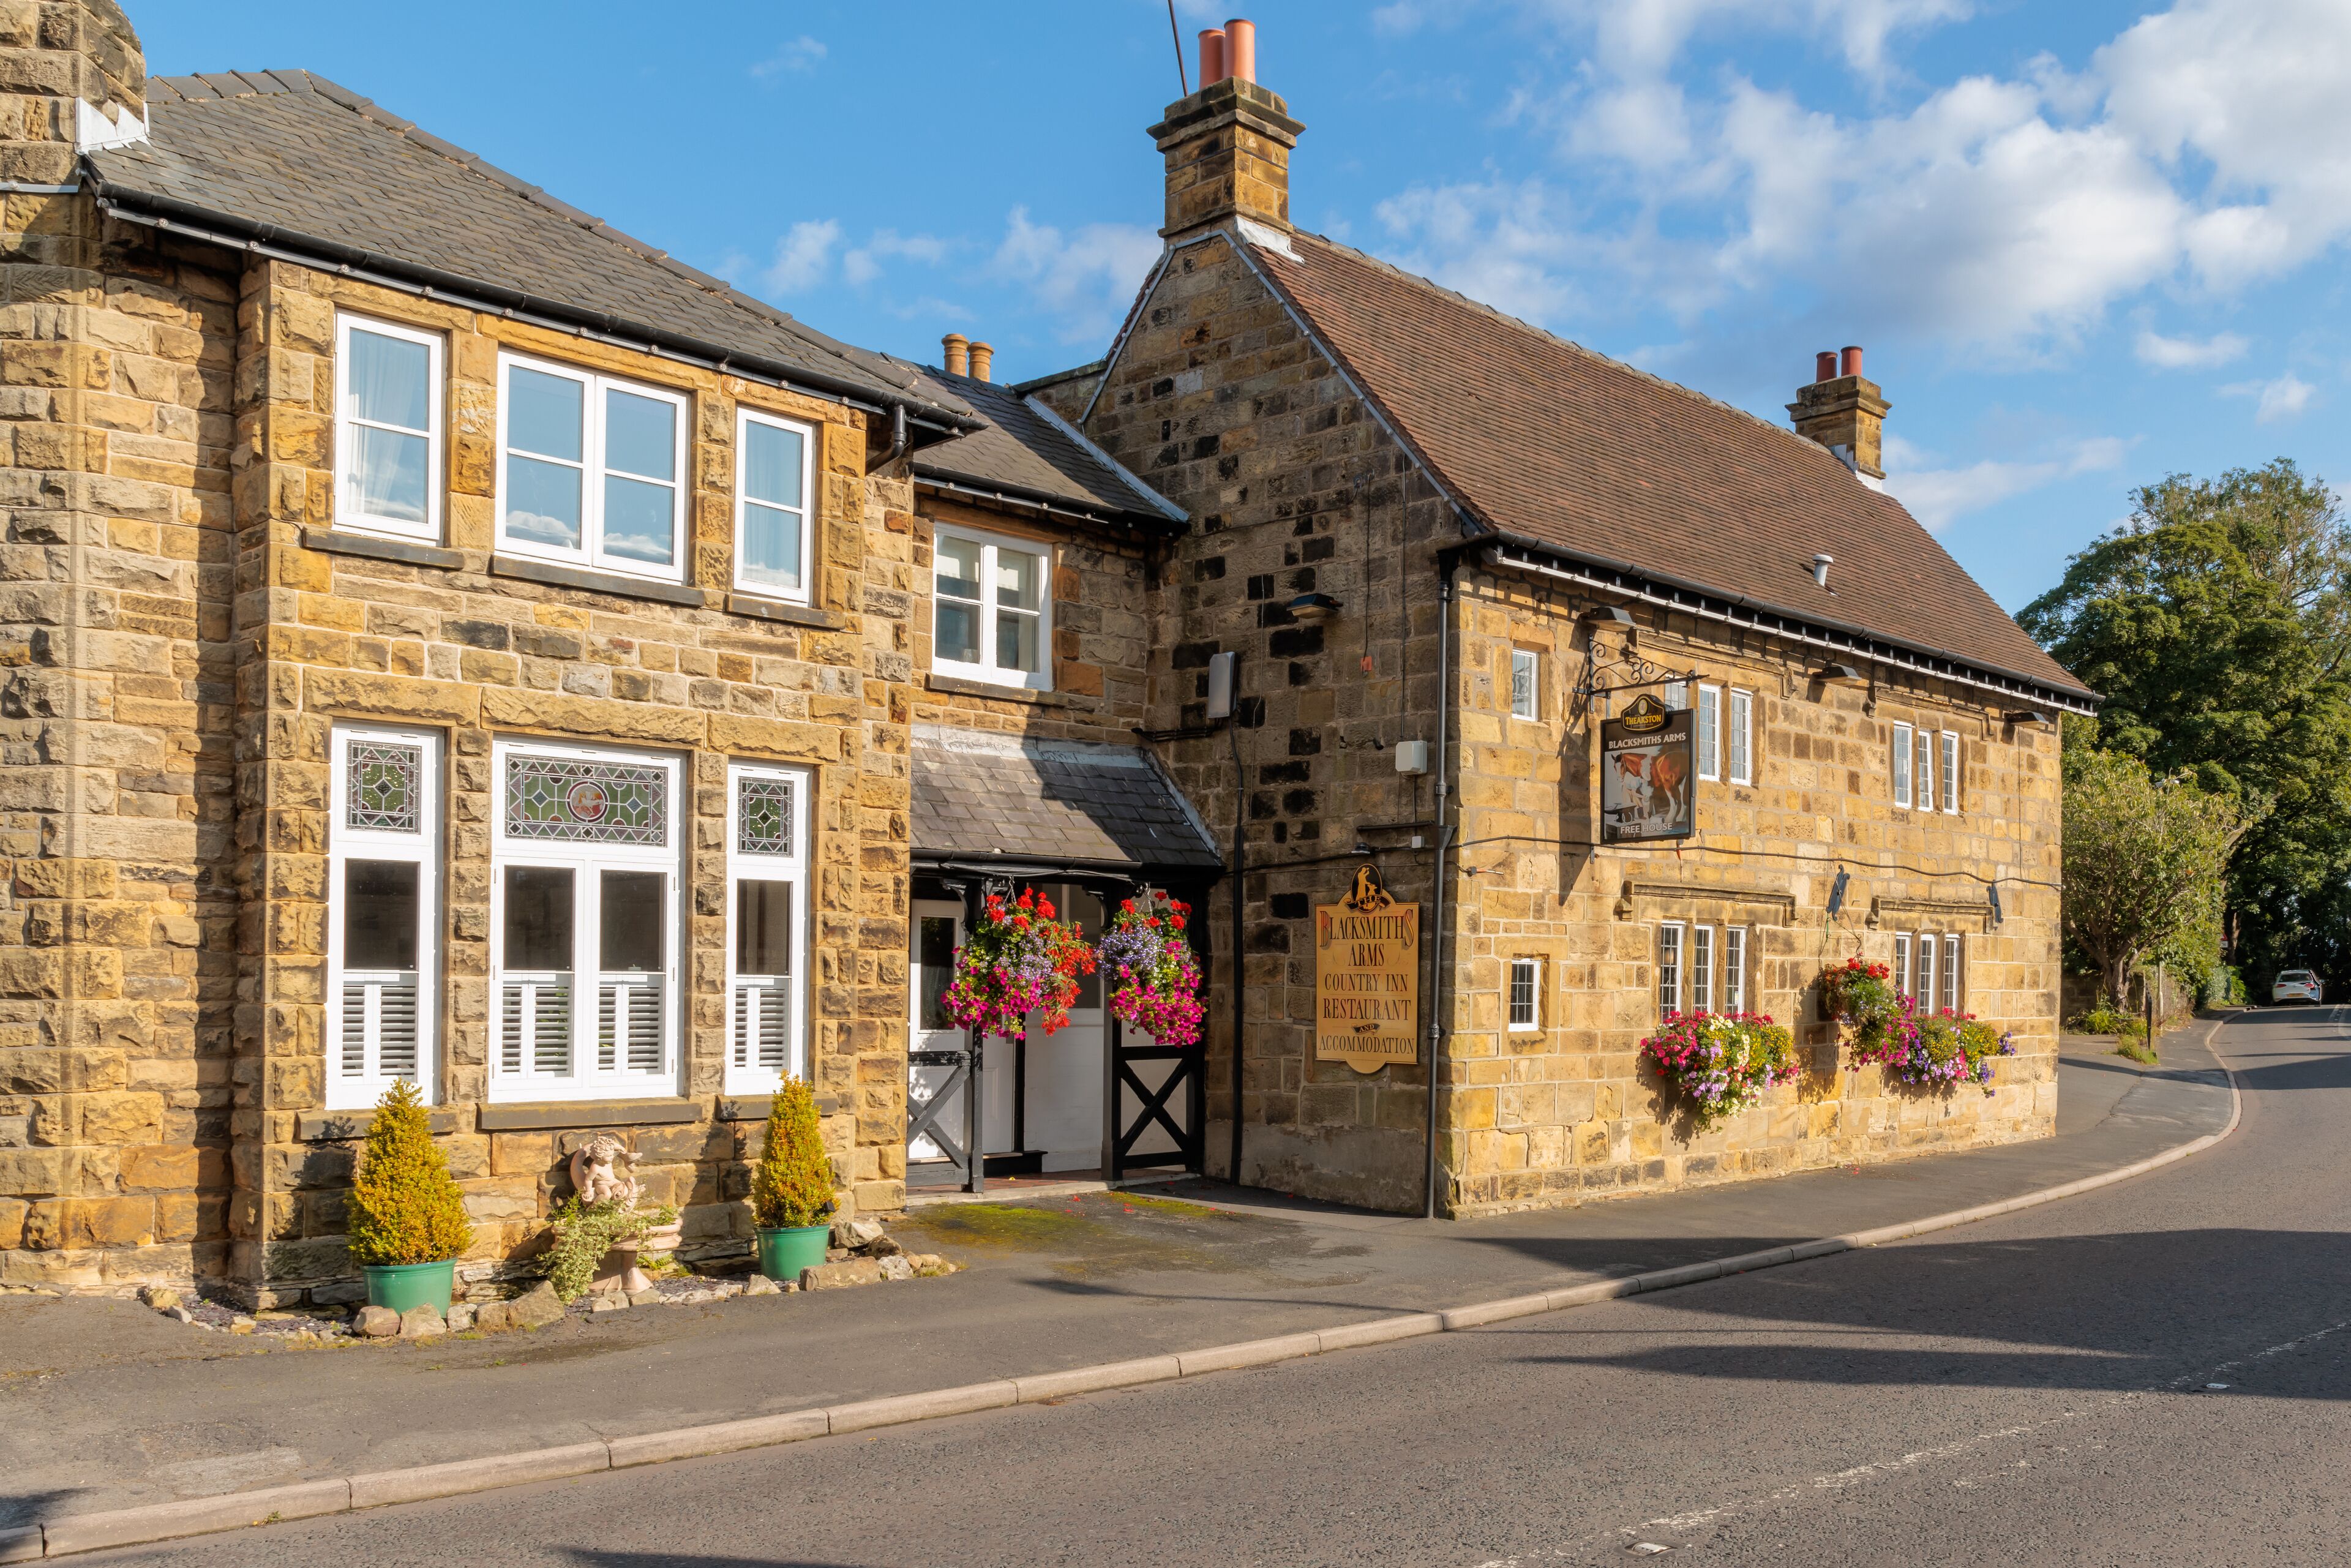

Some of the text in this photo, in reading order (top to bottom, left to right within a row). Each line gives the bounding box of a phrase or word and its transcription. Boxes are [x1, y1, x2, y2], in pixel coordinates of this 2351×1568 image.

[1625, 715, 1661, 725] THEAKSTON
[1608, 732, 1686, 749] BLACKSMITHS ARMS
[1620, 822, 1673, 834] FREE HOUSE
[1355, 896, 1381, 906] THE
[1319, 909, 1415, 948] BLACKSMITHS
[1348, 943, 1385, 967] ARMS
[1324, 973, 1409, 992] COUNTRY INN
[1322, 998, 1411, 1021] RESTAURANT
[1359, 1024, 1374, 1033] AND
[1319, 1035, 1415, 1054] ACCOMMODATION
